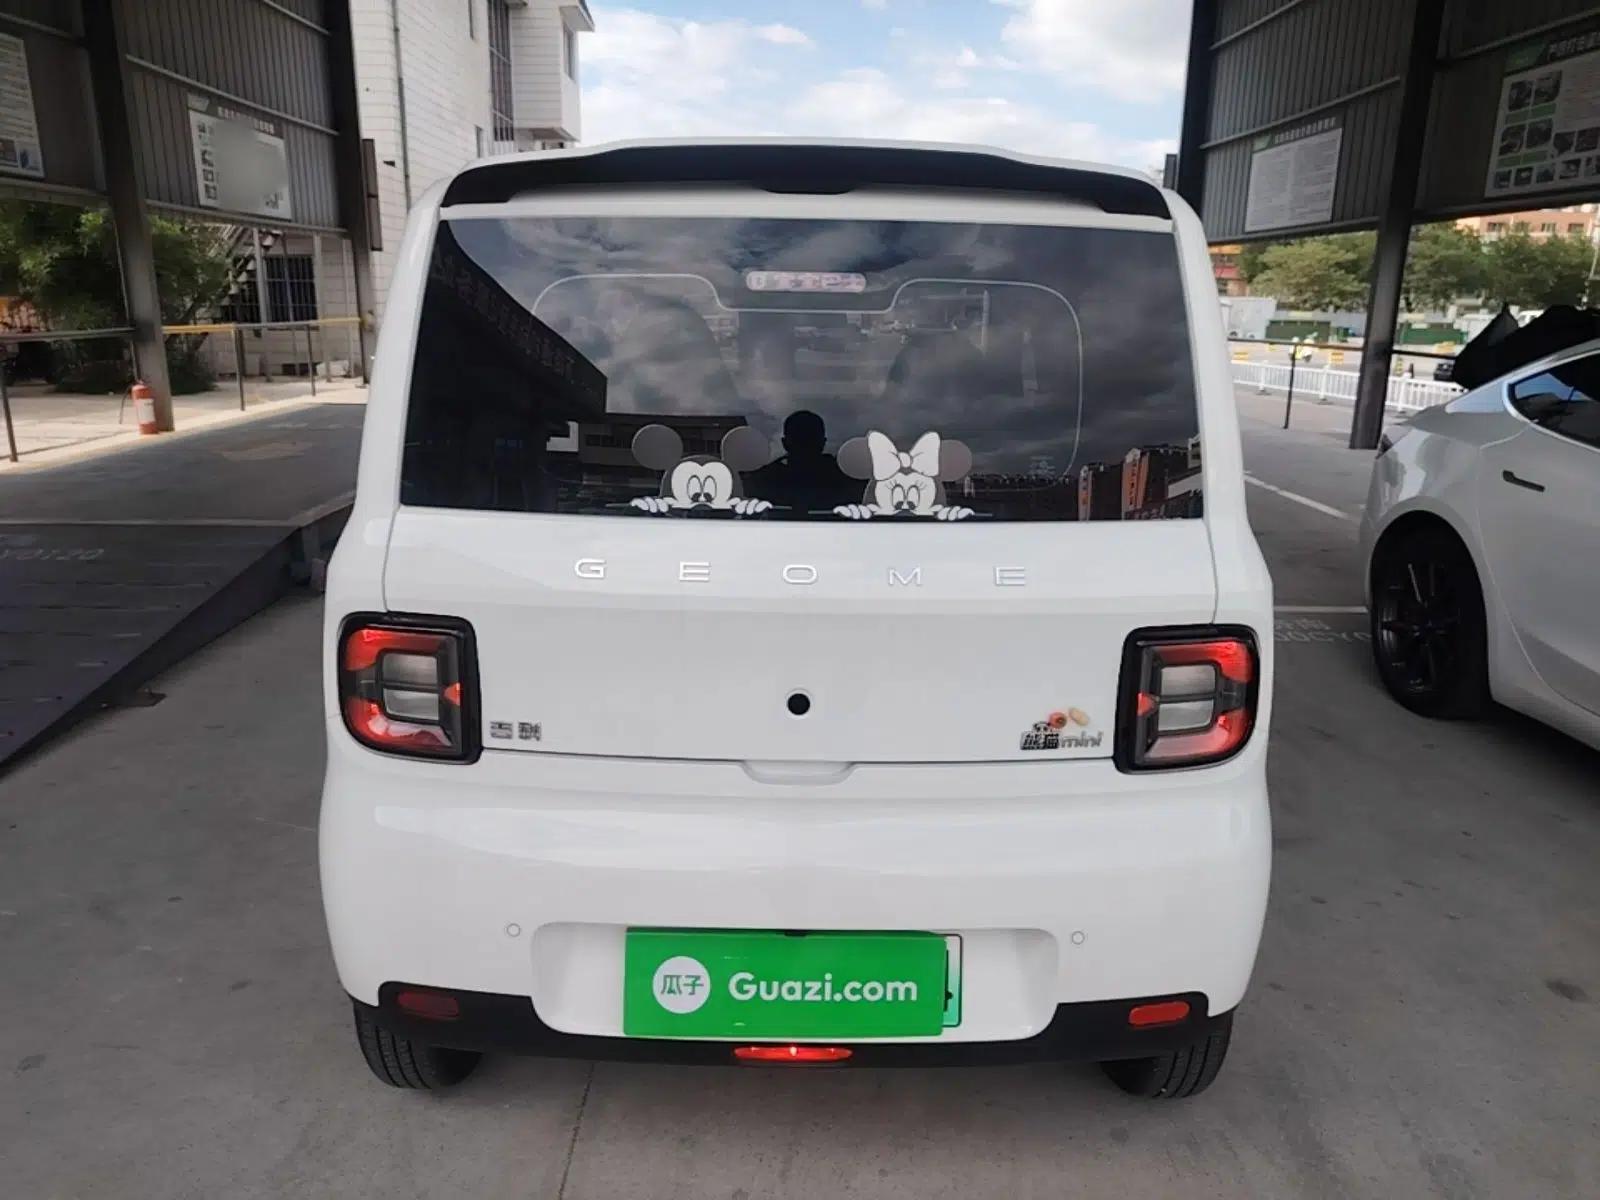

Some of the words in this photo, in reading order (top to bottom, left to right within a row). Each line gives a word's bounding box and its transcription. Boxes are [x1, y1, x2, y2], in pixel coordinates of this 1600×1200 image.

[574, 557, 1026, 587] GEOME
[660, 974, 705, 996] 瓜子
[728, 972, 917, 1002] Guazi.com
